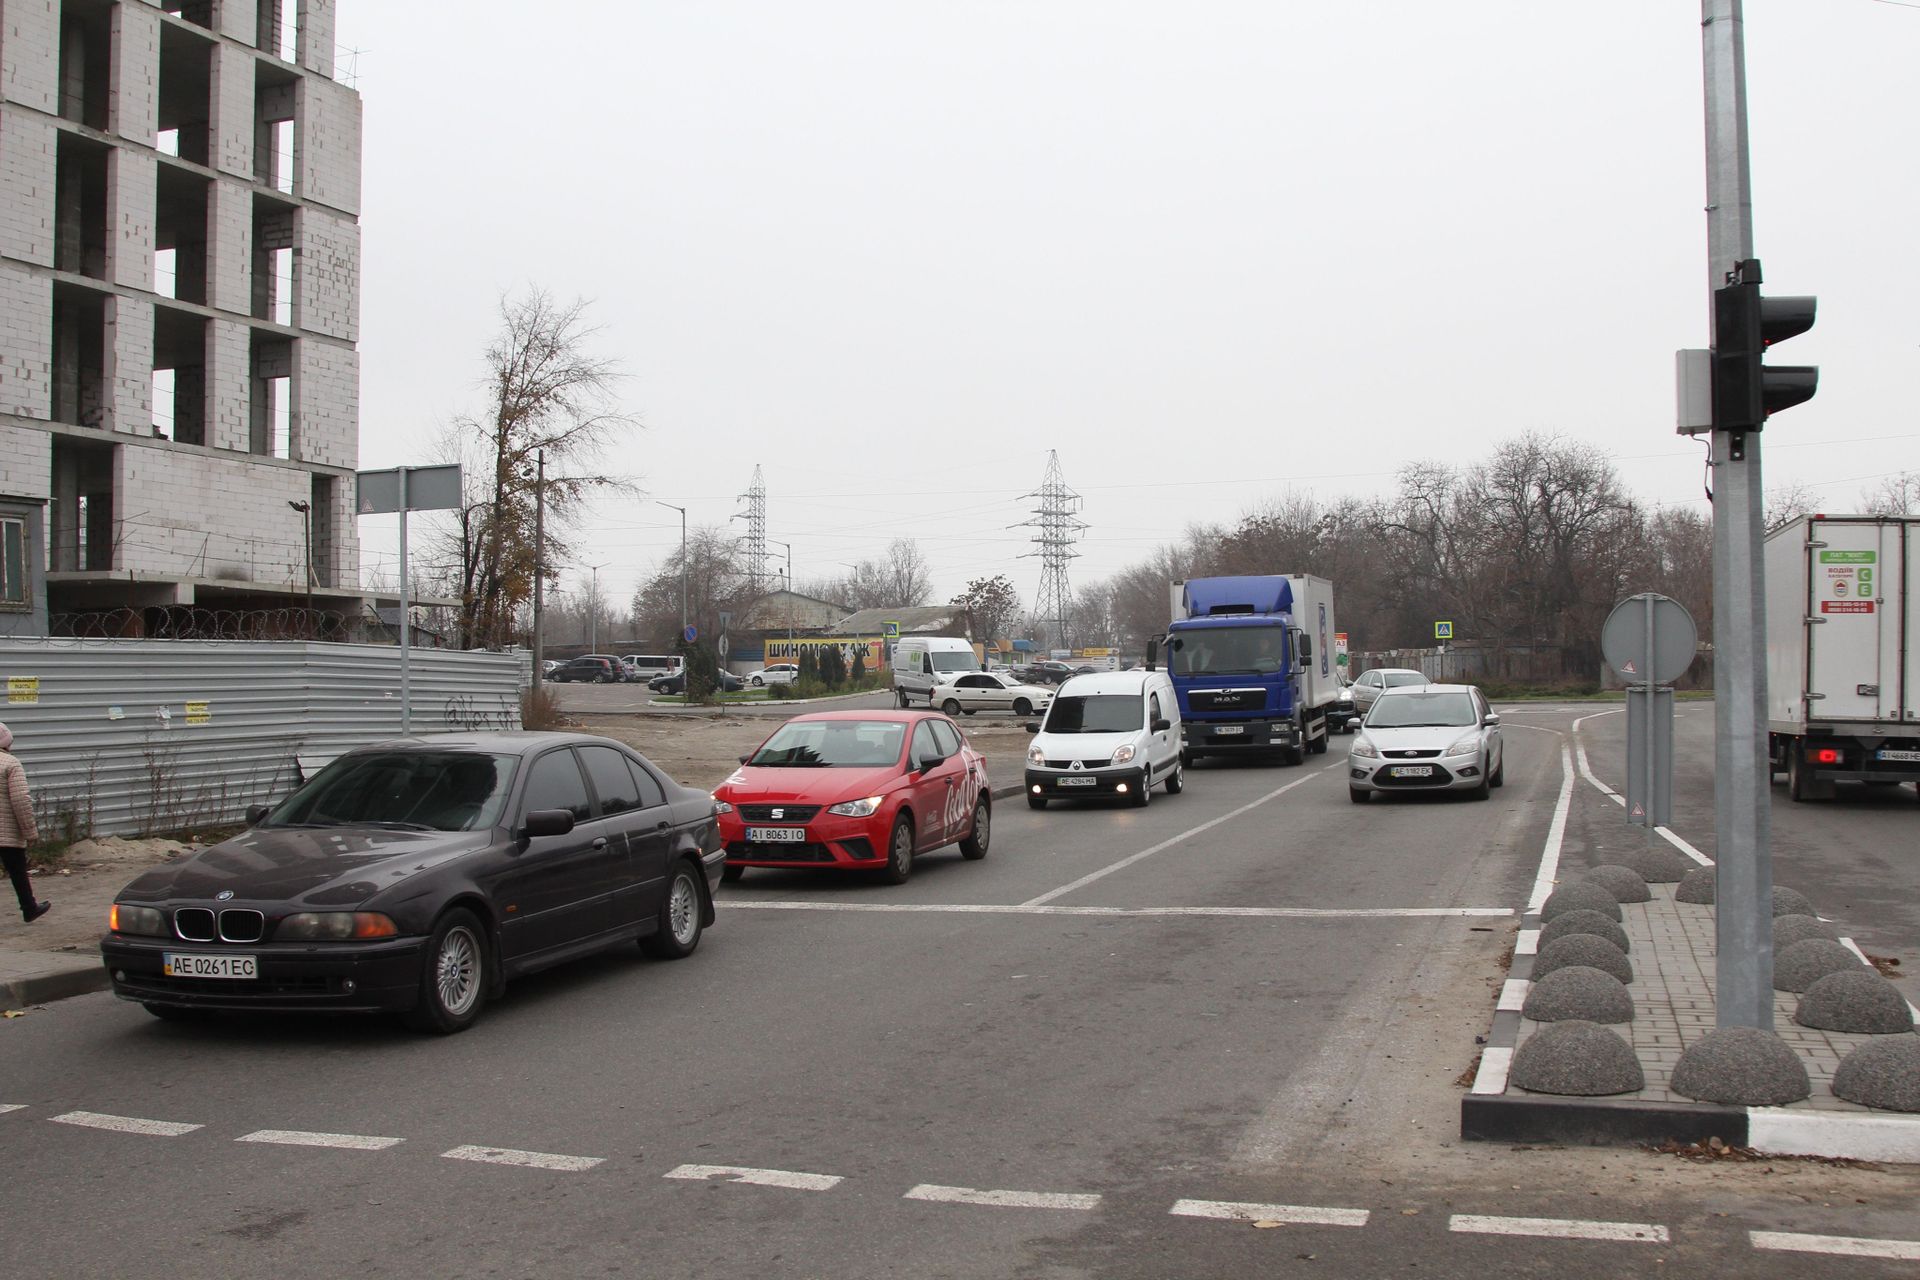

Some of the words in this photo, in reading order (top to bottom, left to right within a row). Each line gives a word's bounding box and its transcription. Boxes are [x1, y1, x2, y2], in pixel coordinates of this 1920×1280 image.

[766, 830, 788, 840] 8063
[173, 957, 193, 973] AE
[195, 958, 228, 975] 0261
